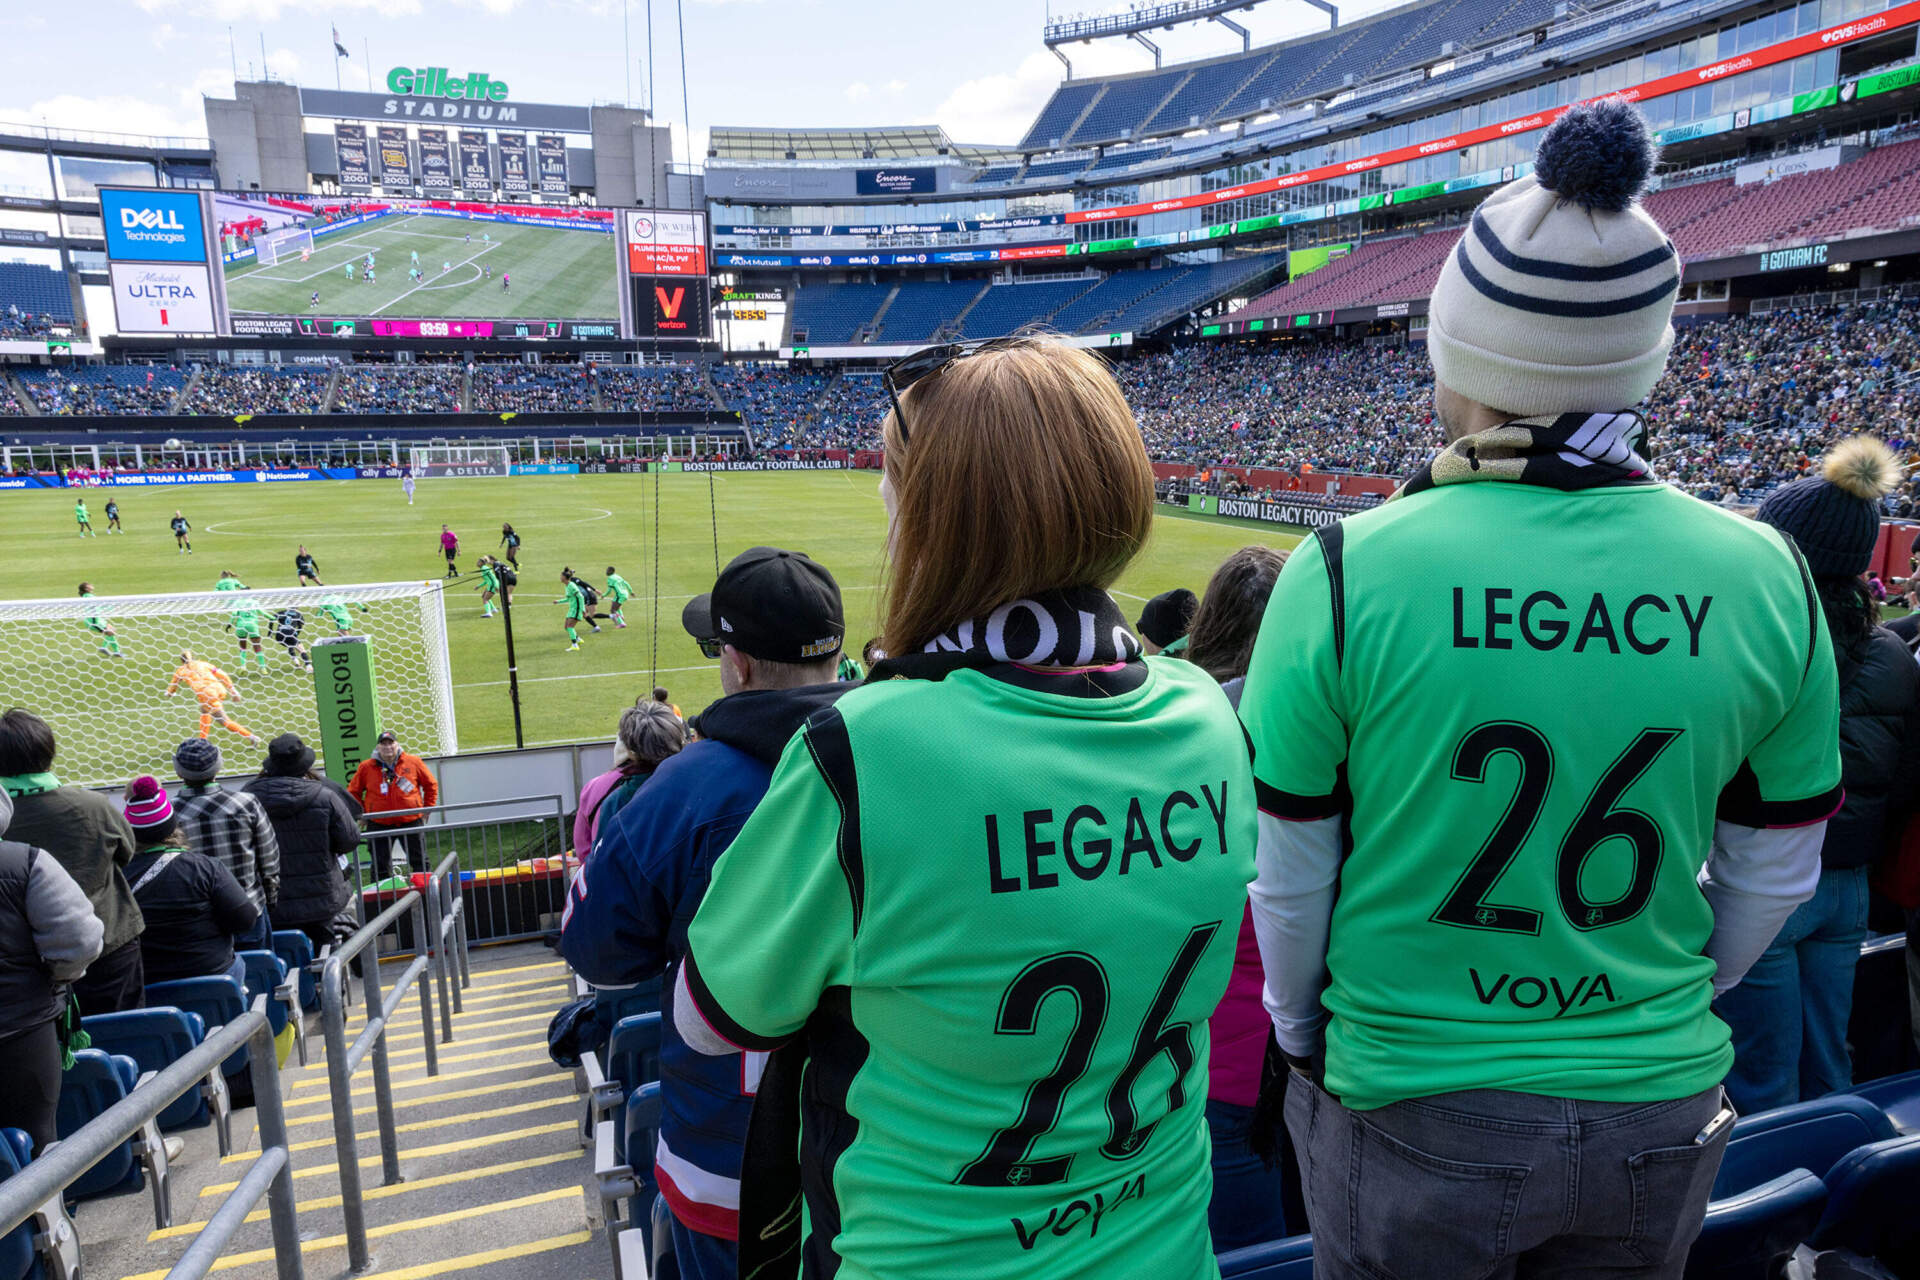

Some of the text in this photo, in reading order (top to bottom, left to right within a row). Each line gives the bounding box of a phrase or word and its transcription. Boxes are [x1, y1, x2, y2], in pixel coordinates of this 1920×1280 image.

[386, 66, 509, 103] Gillette
[1877, 70, 1912, 91] BOSTON
[384, 100, 517, 121] STADIUM
[1665, 123, 1704, 142] GOTHAM FC
[875, 171, 915, 183] Encore
[120, 208, 185, 229] DELL
[895, 225, 919, 233] Gillette
[123, 229, 186, 244] Technologies
[633, 244, 701, 255] PLUMBING, HEATING,
[646, 254, 675, 263] HVAC/R,
[752, 258, 782, 266] Mutual
[1769, 247, 1813, 269] GOTHAM
[1813, 244, 1828, 264] FC
[128, 285, 196, 298] ULTRA
[723, 291, 782, 301] DRAFTKINGS
[734, 310, 767, 321] 93:59
[234, 320, 293, 328] BOSTON LEGACY
[419, 321, 449, 336] 93:59
[657, 321, 687, 329] verizon
[578, 325, 605, 336] GOTHAM
[605, 326, 614, 336] FC
[457, 466, 497, 475] DELTA
[684, 460, 841, 471] BOSTON LEGACY FOOTBALL CLUB
[115, 475, 146, 484] MORE
[146, 474, 176, 483] THAN
[176, 474, 186, 482] A
[187, 473, 235, 482] PARTNER.
[266, 471, 310, 481] Nationwide
[362, 468, 379, 478] ally
[1218, 499, 1258, 518] BOSTON
[1260, 505, 1301, 524] LEGACY
[1452, 586, 1714, 658] LEGACY
[331, 652, 358, 740] BOSTON
[1428, 720, 1686, 937] 26
[984, 780, 1229, 894] LEGACY
[950, 919, 1223, 1187] 26
